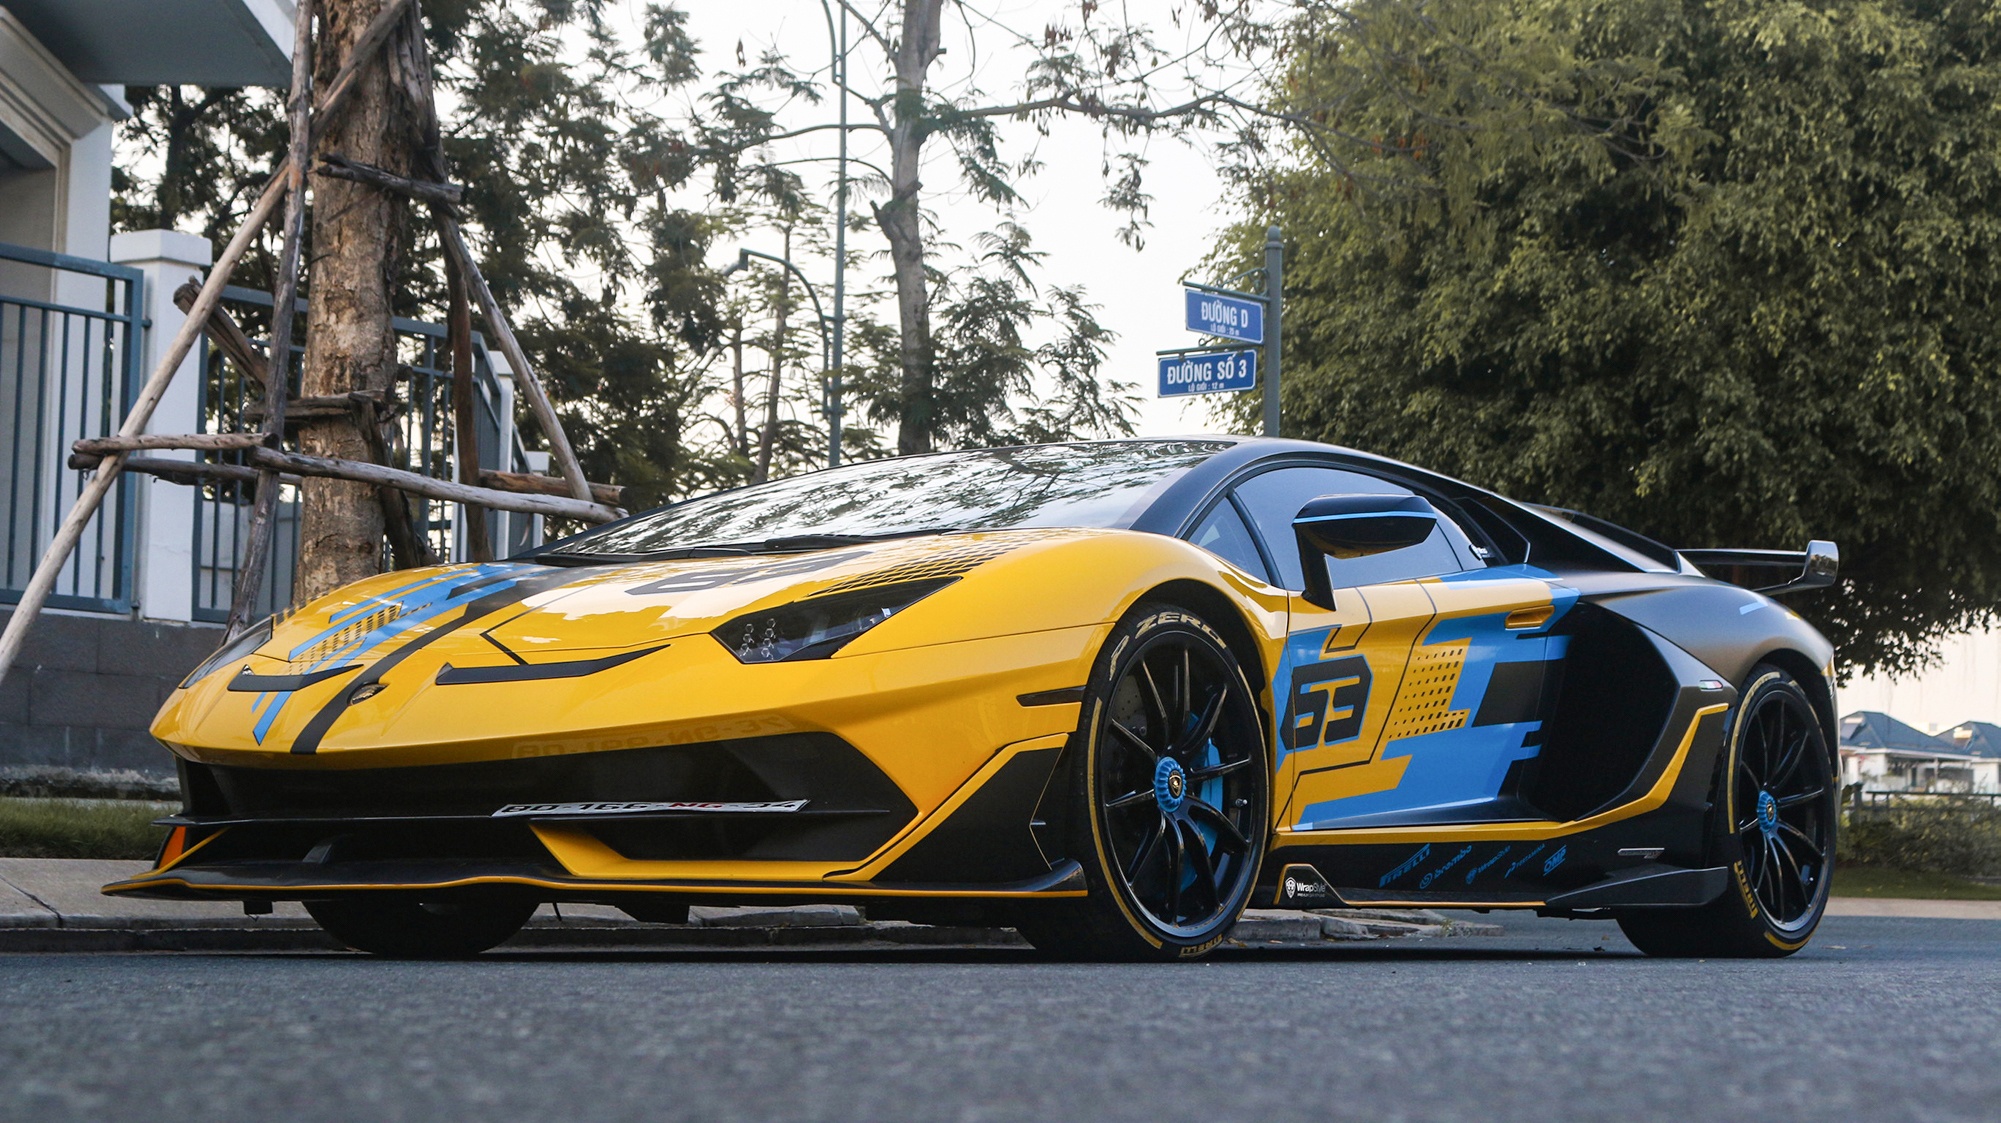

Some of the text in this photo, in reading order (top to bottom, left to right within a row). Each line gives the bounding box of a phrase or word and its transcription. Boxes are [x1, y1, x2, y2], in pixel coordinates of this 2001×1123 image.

[1201, 300, 1249, 328] ĐƯỜNG D
[1167, 352, 1247, 385] ĐƯỜNG SỐ 3
[1280, 655, 1373, 752] 63
[1543, 845, 1567, 876] OMP
